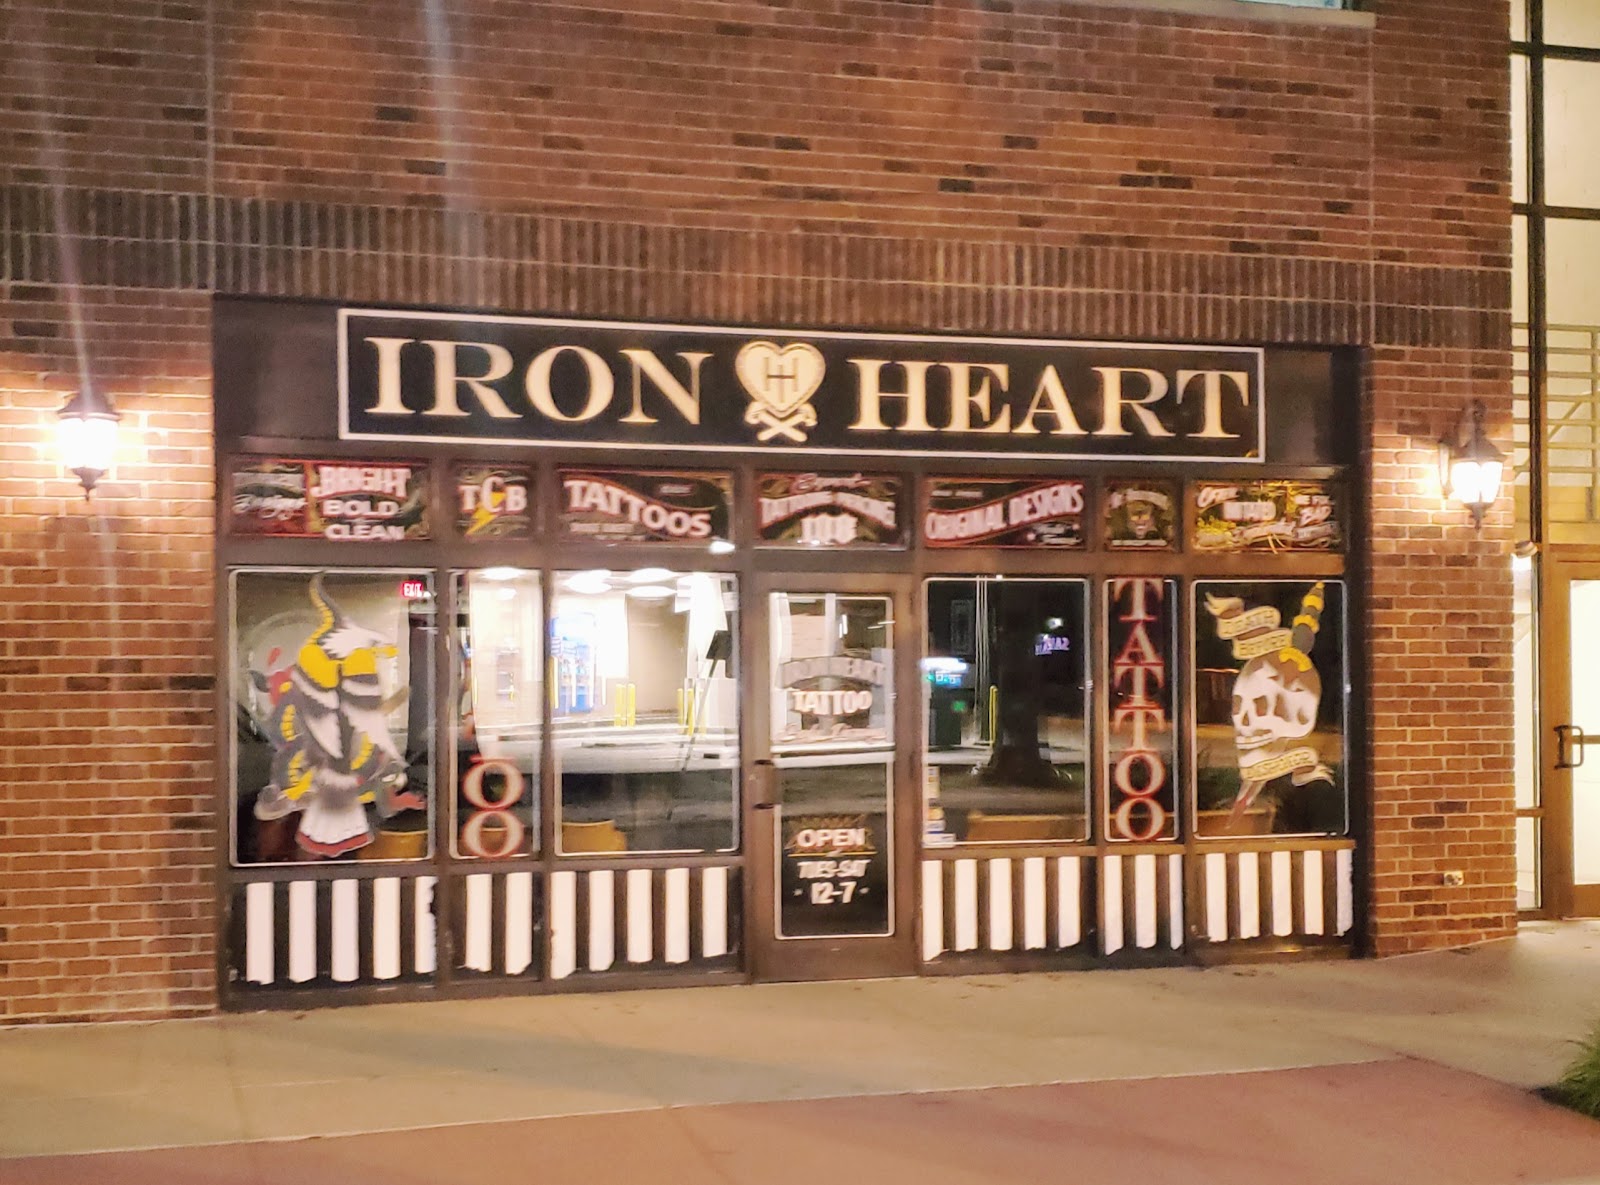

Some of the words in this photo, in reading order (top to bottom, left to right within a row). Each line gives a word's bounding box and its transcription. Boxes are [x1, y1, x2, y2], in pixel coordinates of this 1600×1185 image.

[364, 336, 714, 425] IRON
[846, 358, 1249, 438] HEART
[458, 476, 527, 513] TCB
[322, 499, 400, 517] BOLD
[563, 479, 712, 537] TATTOOS
[324, 523, 405, 541] CLEAN
[403, 582, 422, 598] EXIT
[791, 690, 873, 716] TATTOO
[1113, 577, 1166, 841] TATTOO
[796, 828, 866, 848] OPEN
[811, 881, 857, 905] 12-7
